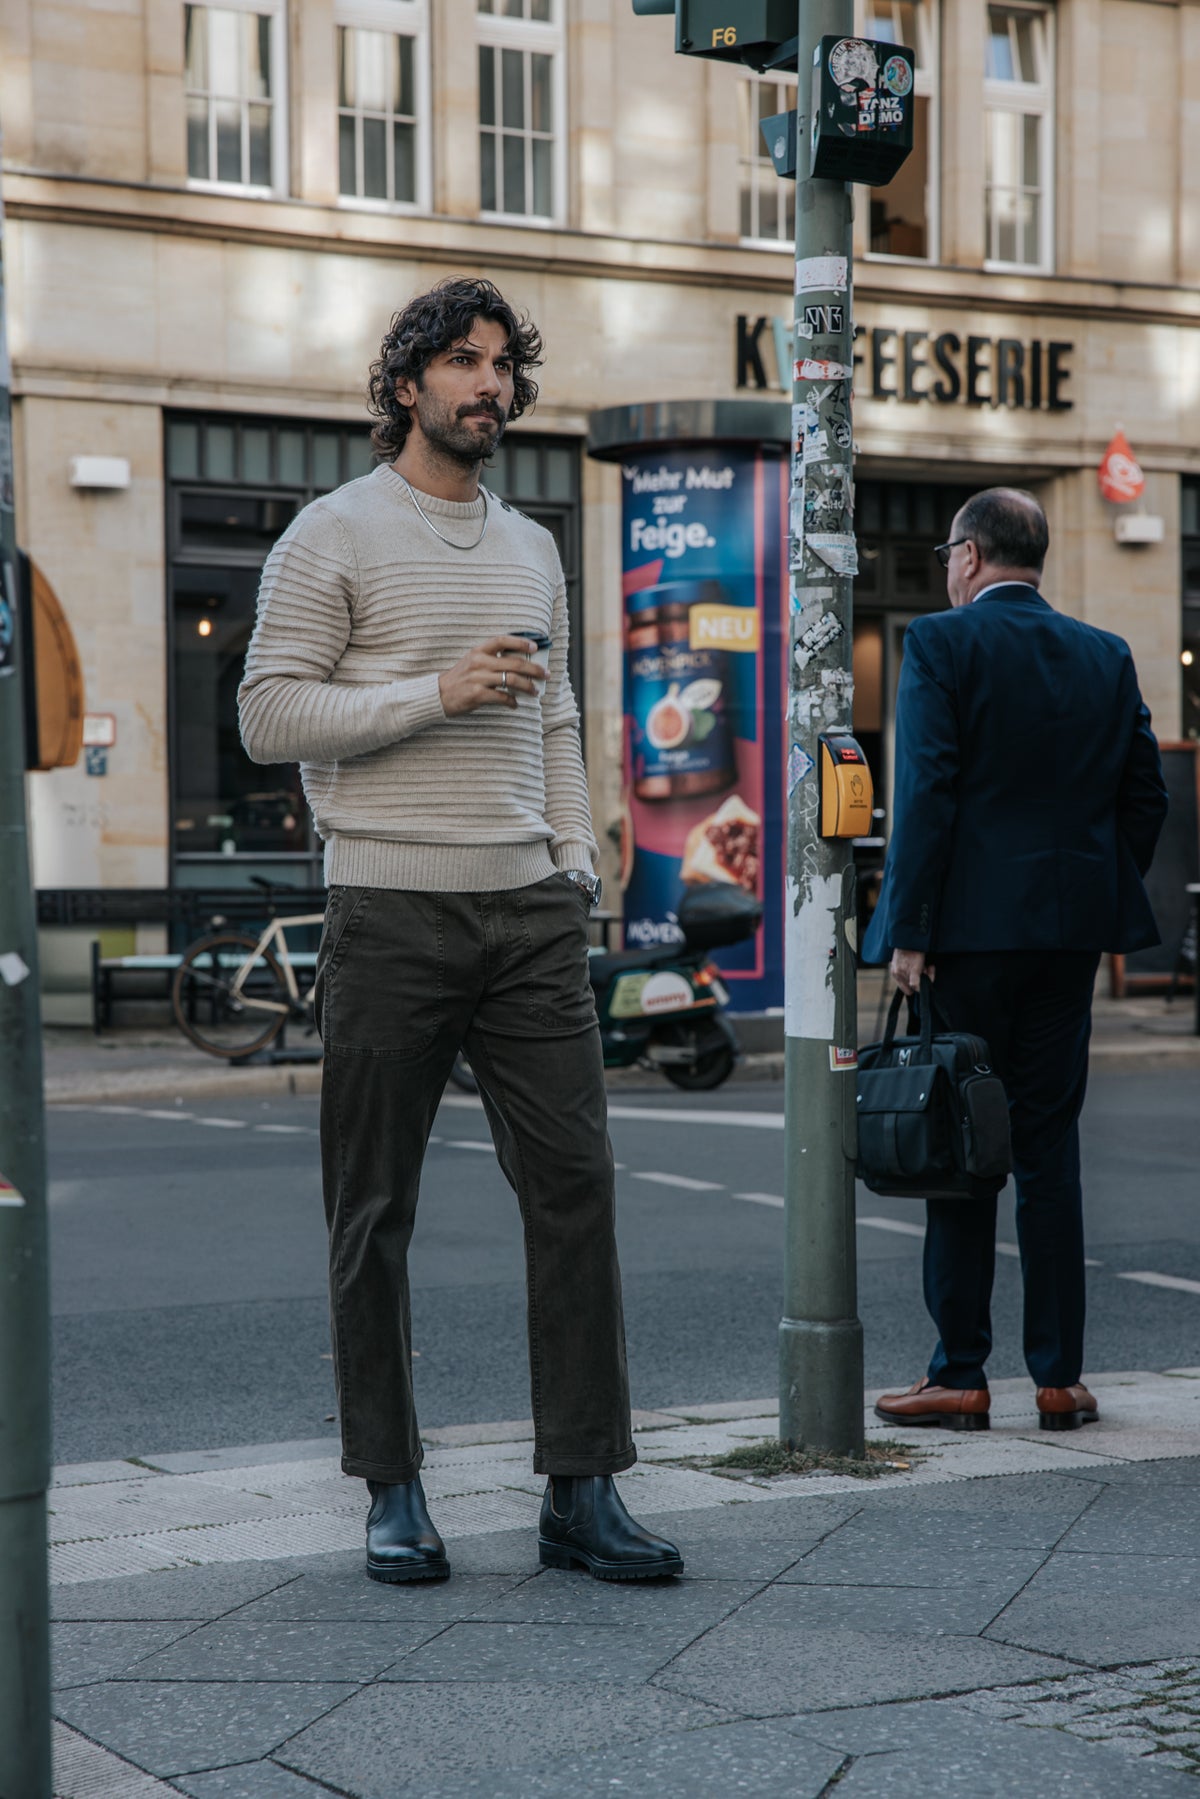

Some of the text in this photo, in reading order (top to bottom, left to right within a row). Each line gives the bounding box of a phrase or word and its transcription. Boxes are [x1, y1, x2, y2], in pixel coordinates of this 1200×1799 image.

[711, 26, 737, 48] F6
[632, 465, 735, 493] Mehr Mut
[651, 494, 688, 515] zur
[630, 516, 717, 559] Feige.
[697, 615, 754, 641] NEU
